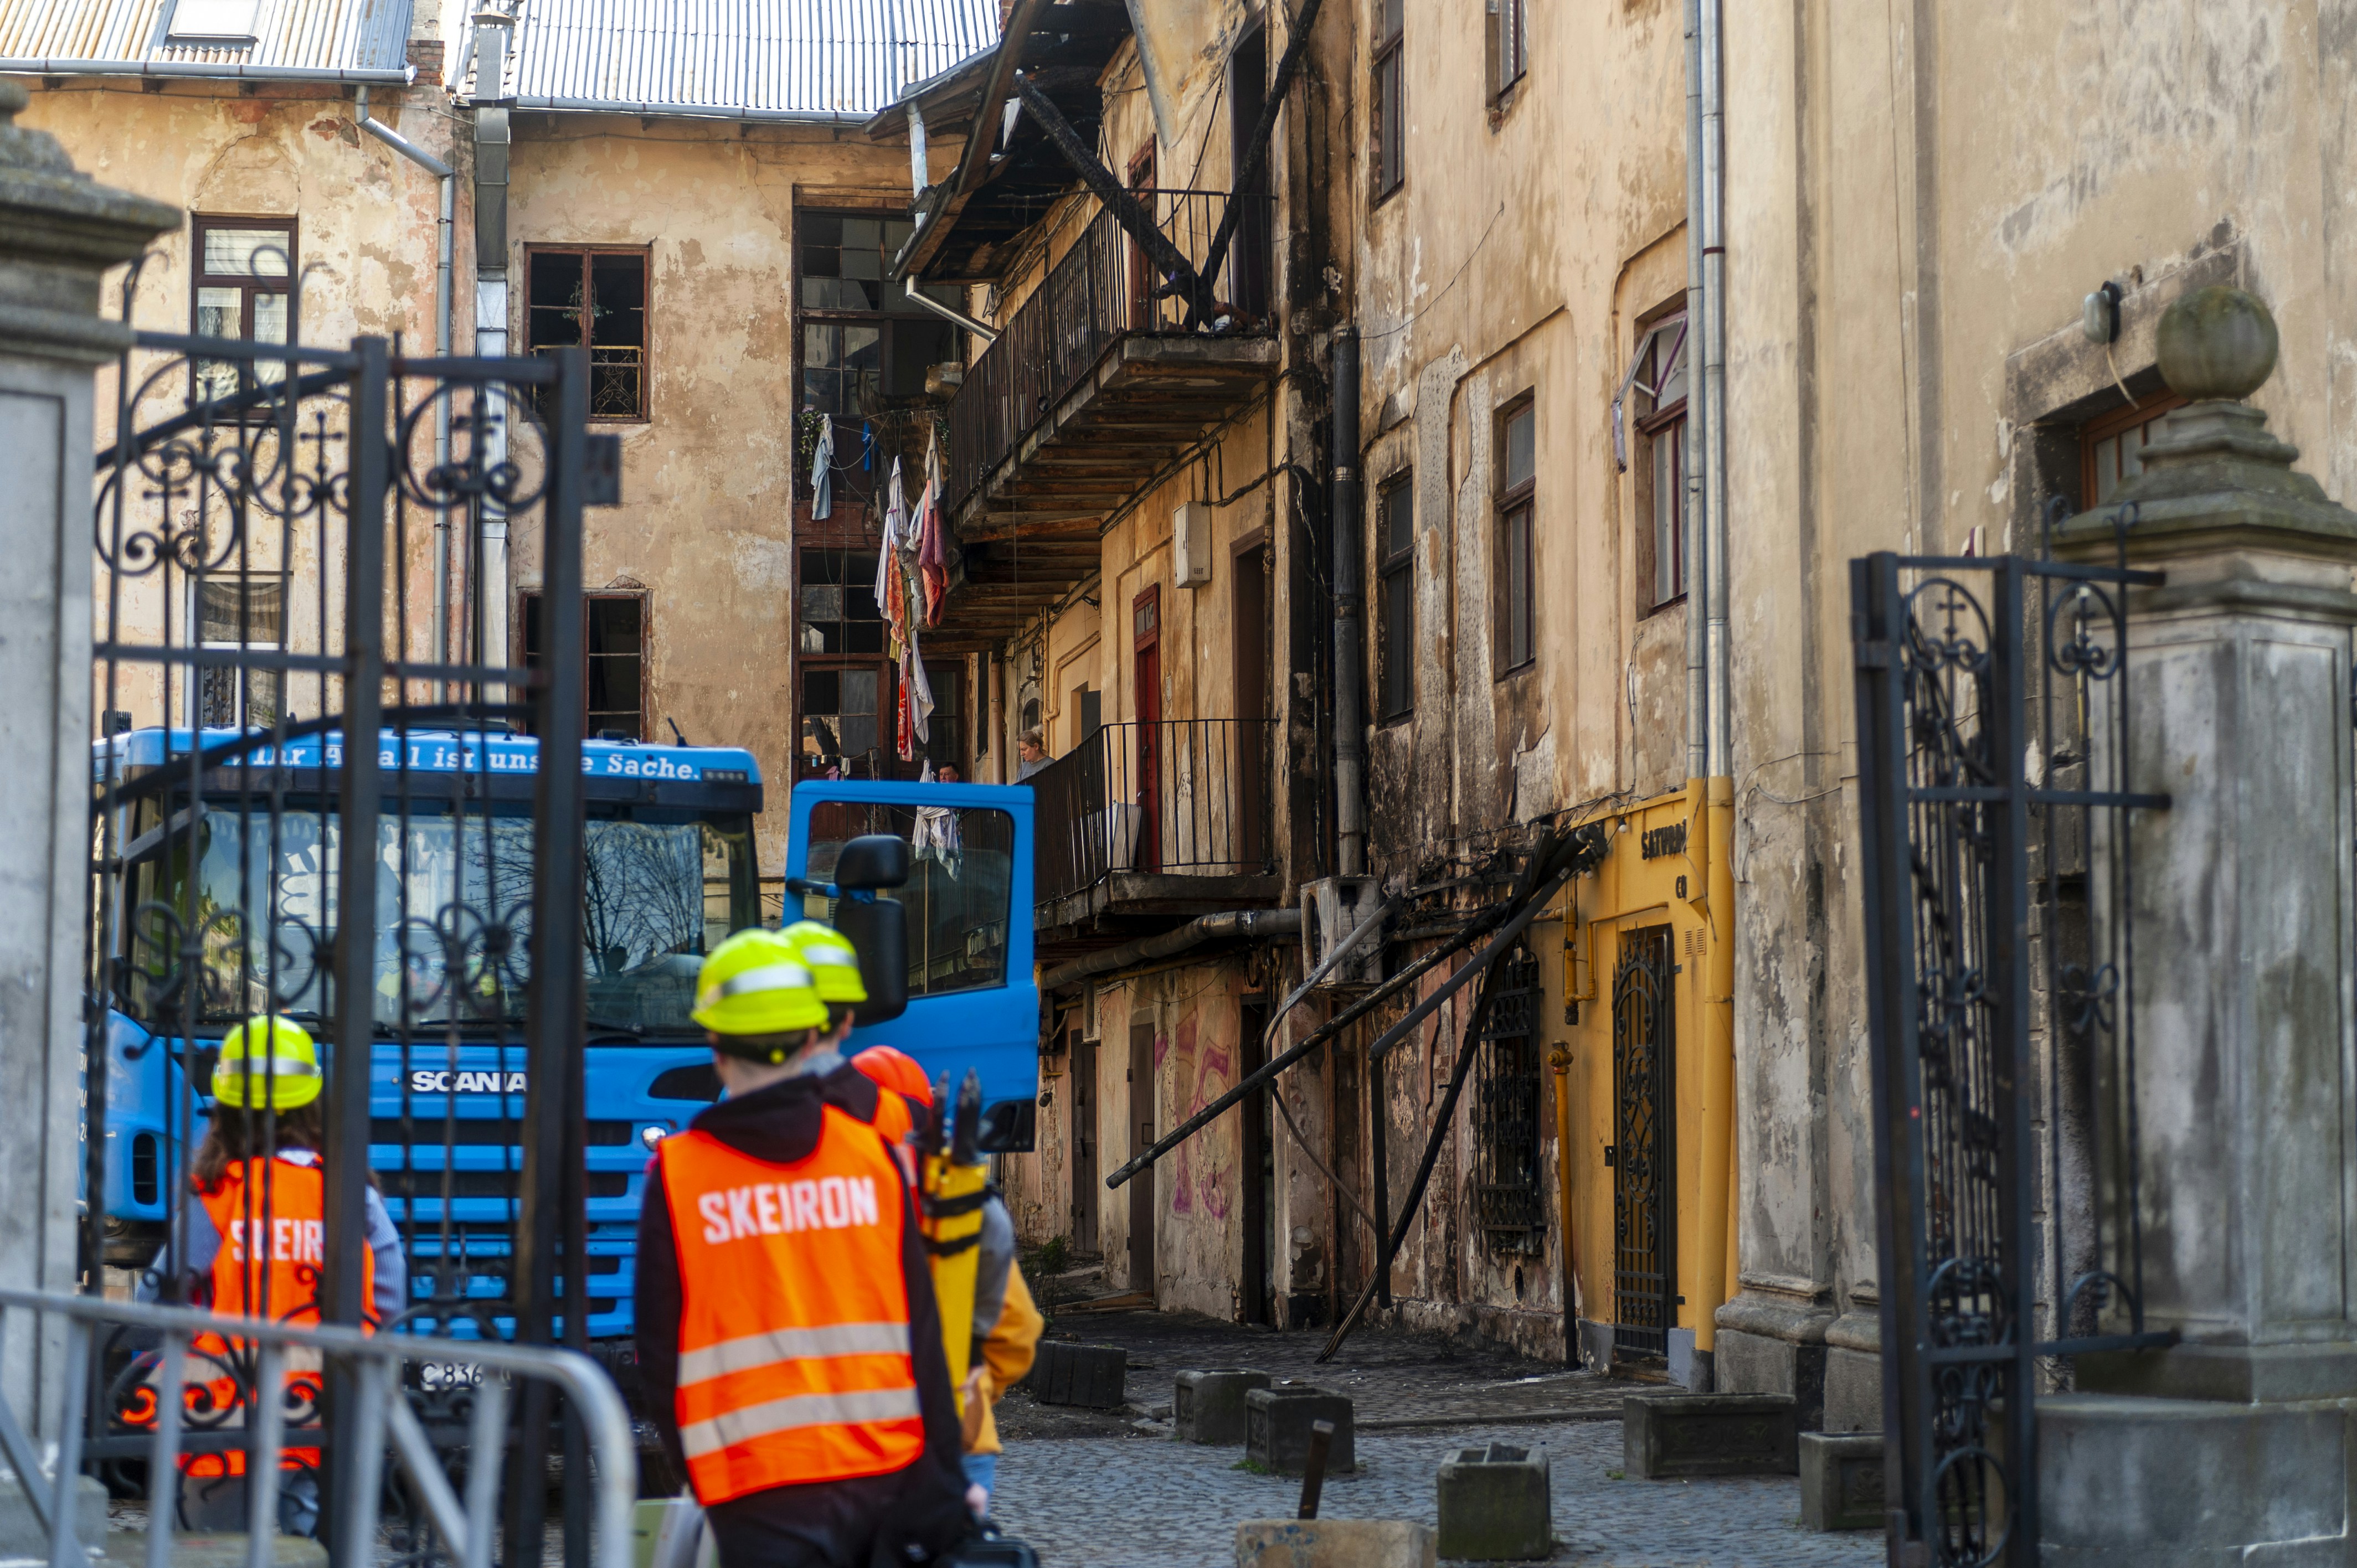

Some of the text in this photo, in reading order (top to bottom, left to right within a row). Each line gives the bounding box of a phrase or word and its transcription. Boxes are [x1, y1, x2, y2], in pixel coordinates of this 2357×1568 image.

[490, 752, 594, 771] unse
[607, 754, 699, 780] Sache.
[698, 1176, 878, 1244] SKEIRON
